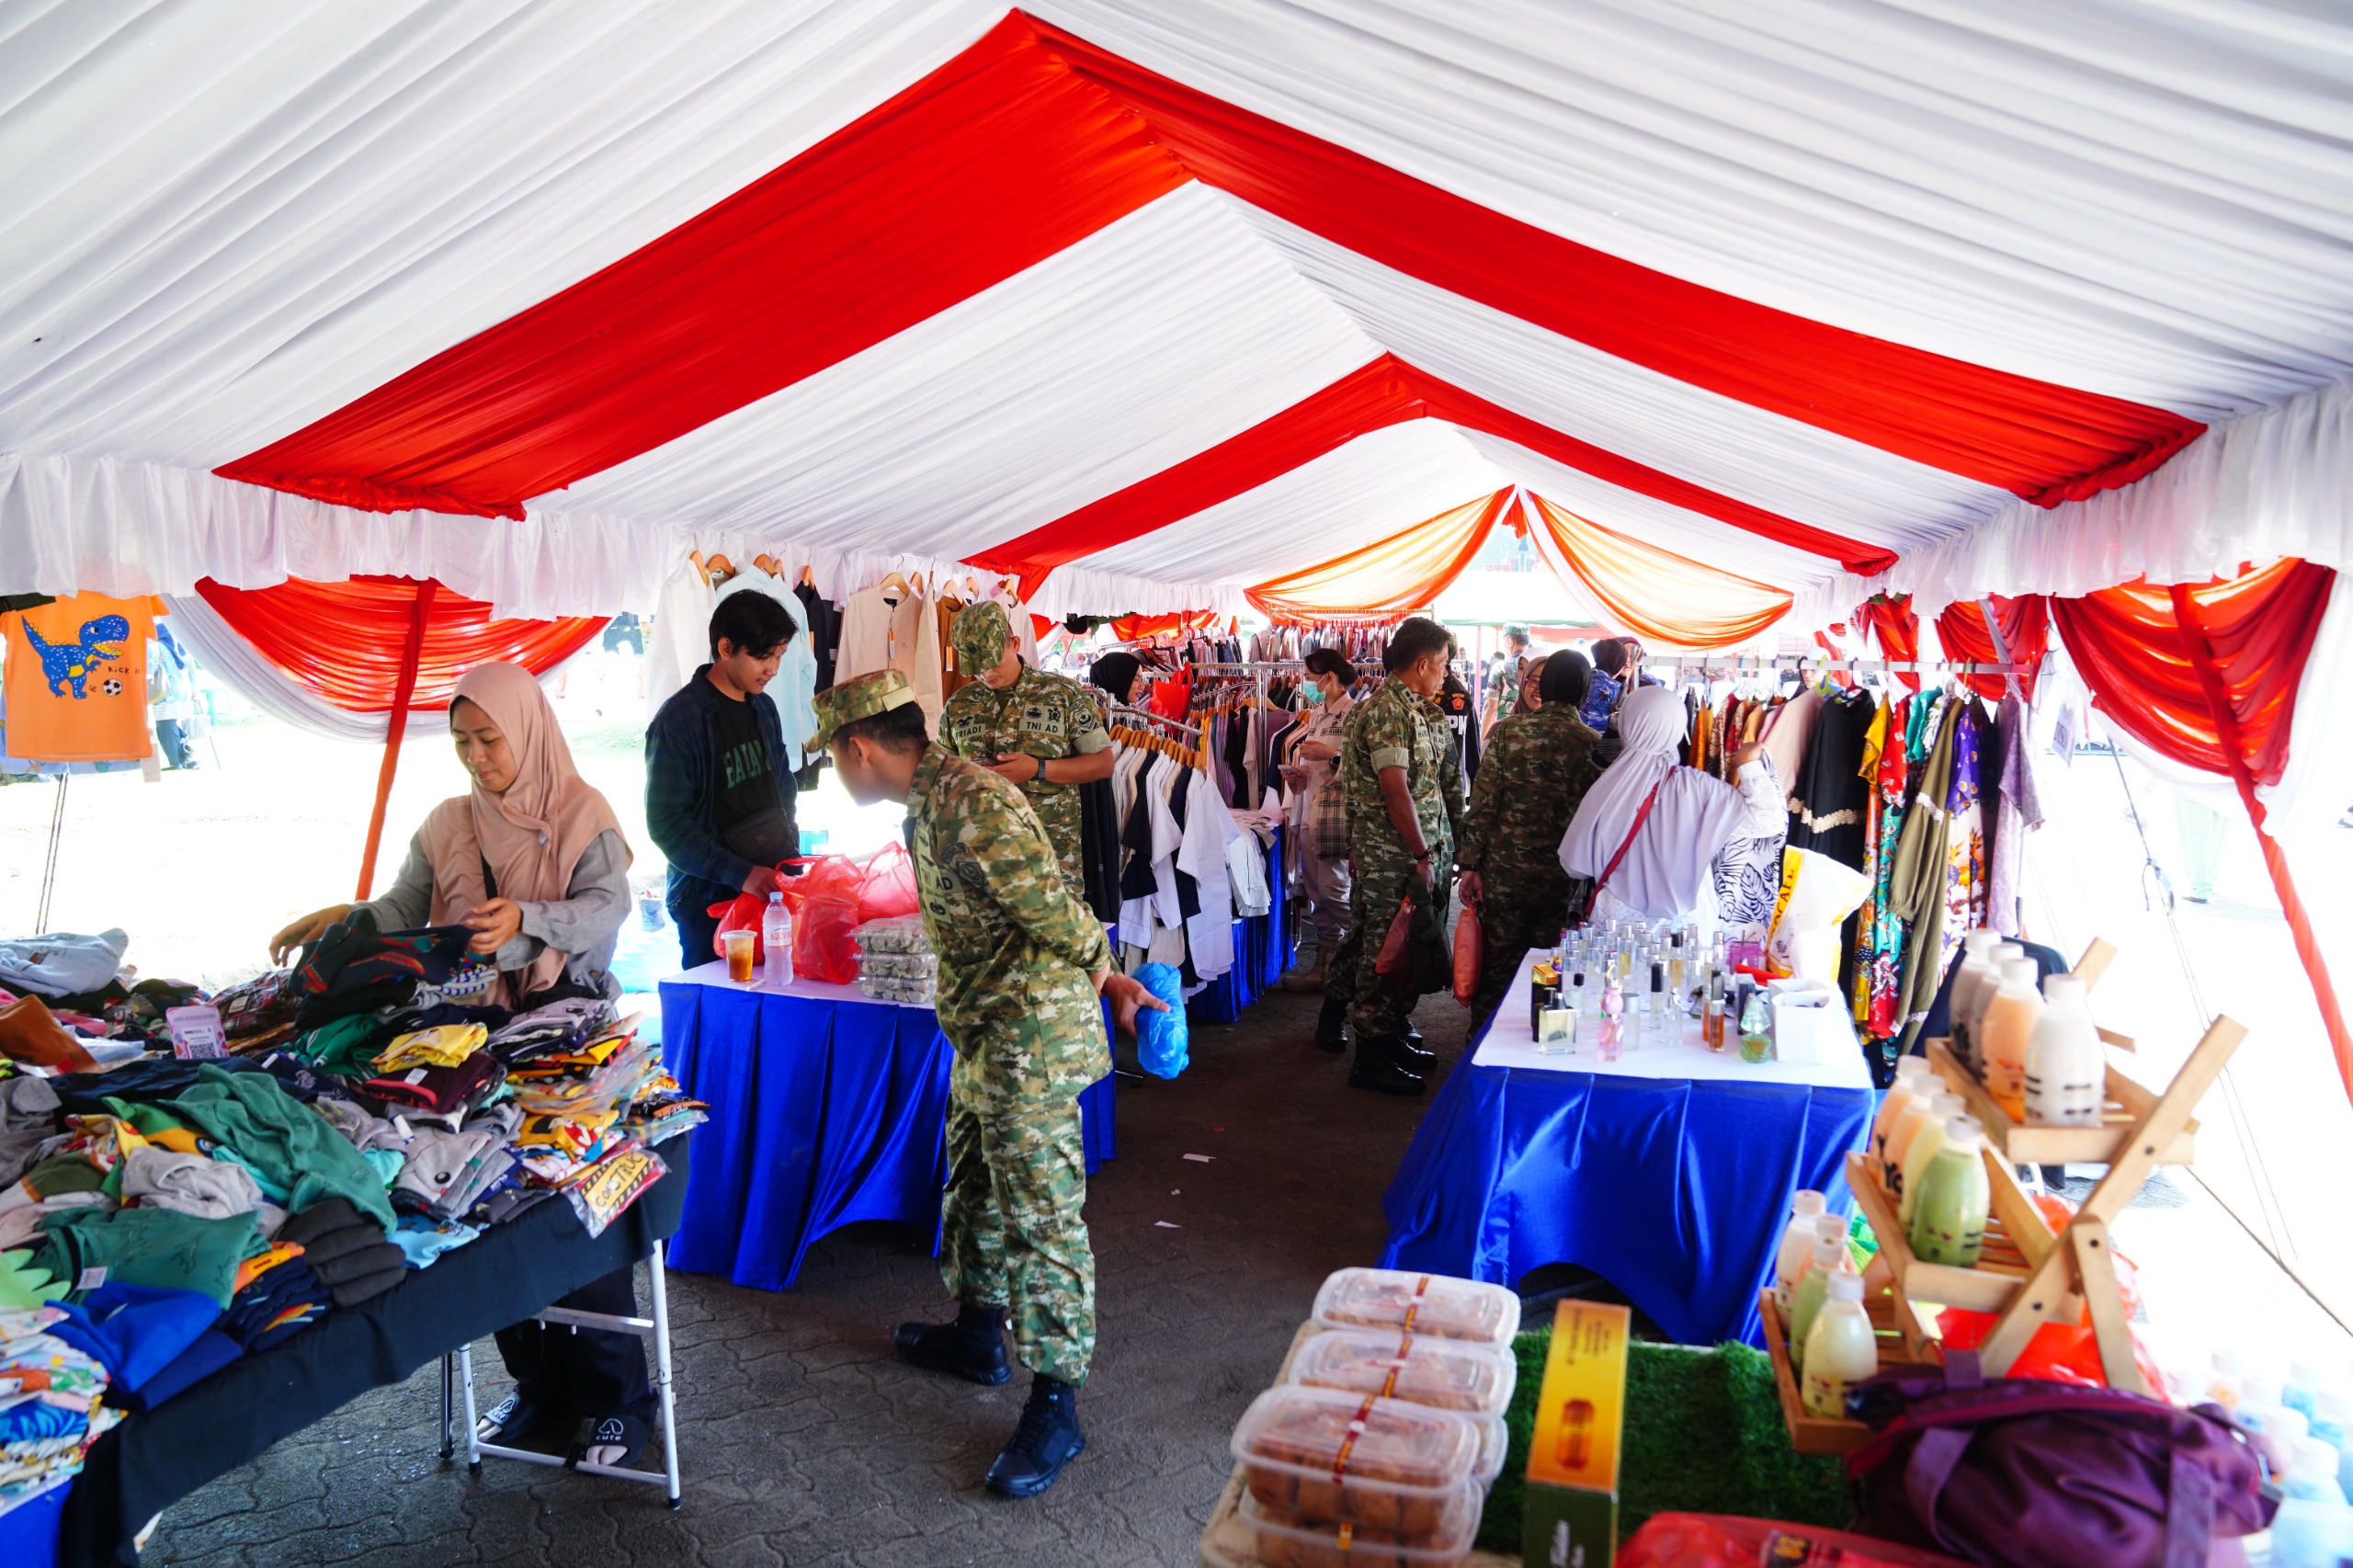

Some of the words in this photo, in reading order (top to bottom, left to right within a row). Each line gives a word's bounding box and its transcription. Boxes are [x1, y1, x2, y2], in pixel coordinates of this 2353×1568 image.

[1026, 722, 1041, 731] TNI
[1045, 723, 1059, 733] AD
[936, 875, 953, 891] AD
[596, 1434, 621, 1442] cute
